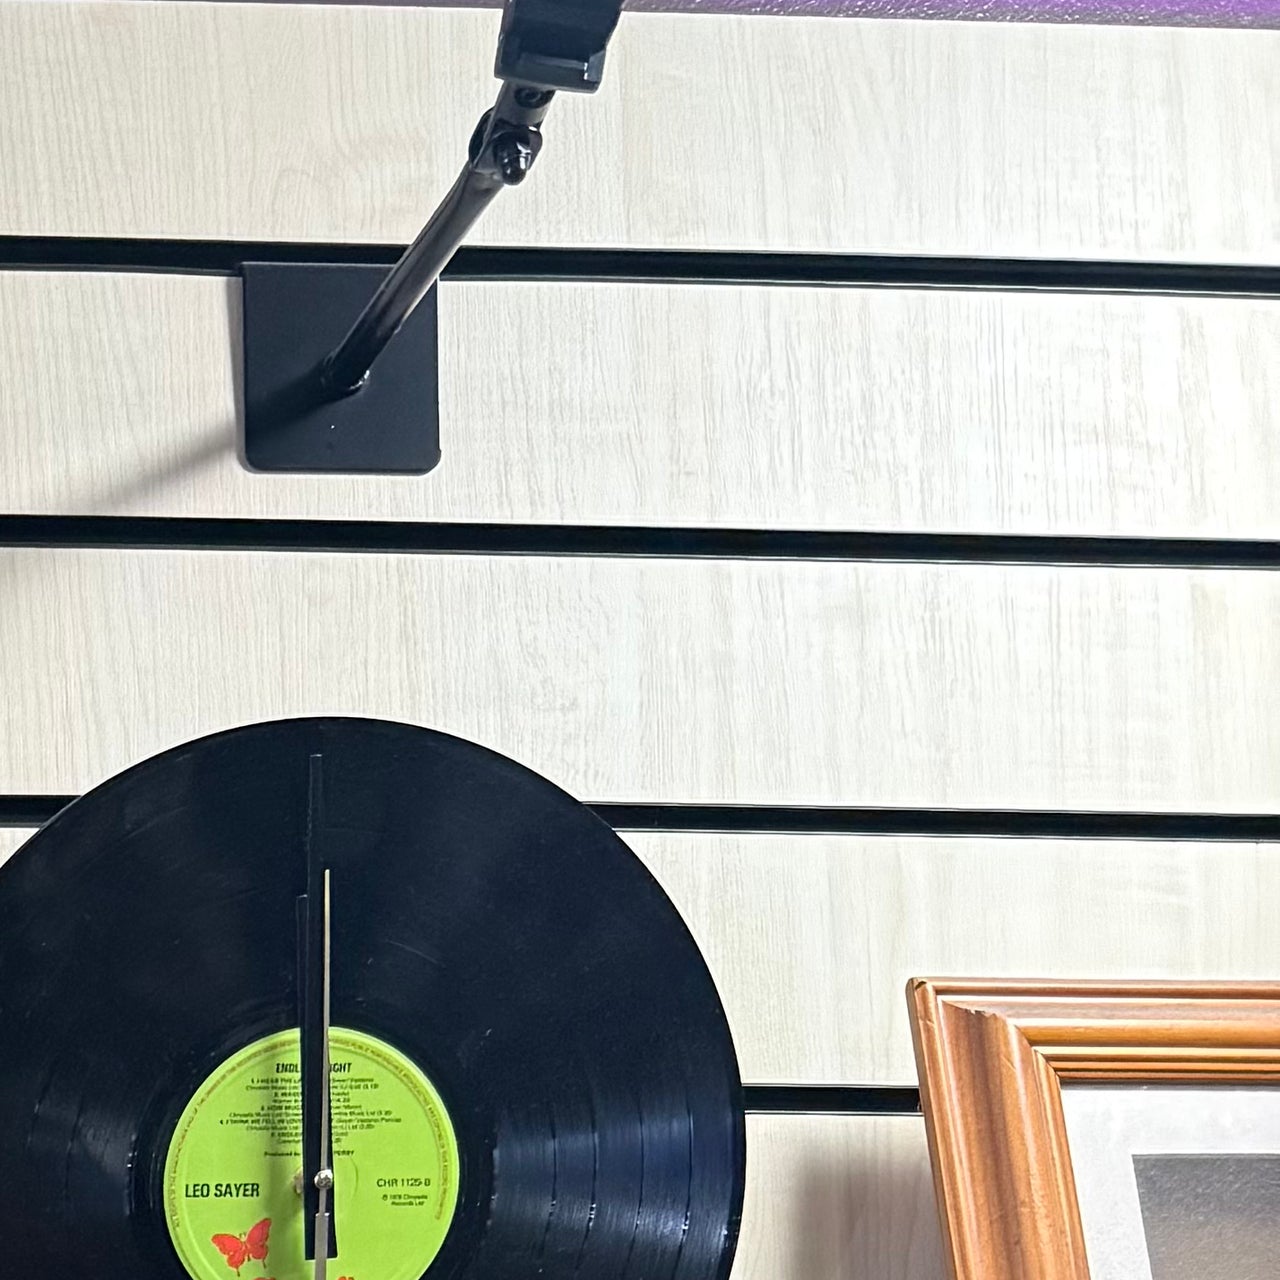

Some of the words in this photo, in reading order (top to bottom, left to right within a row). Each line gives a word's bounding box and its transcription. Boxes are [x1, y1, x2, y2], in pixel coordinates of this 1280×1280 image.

[276, 1062, 301, 1074] ENDL
[185, 1183, 210, 1198] LEO
[214, 1182, 260, 1198] SAYER
